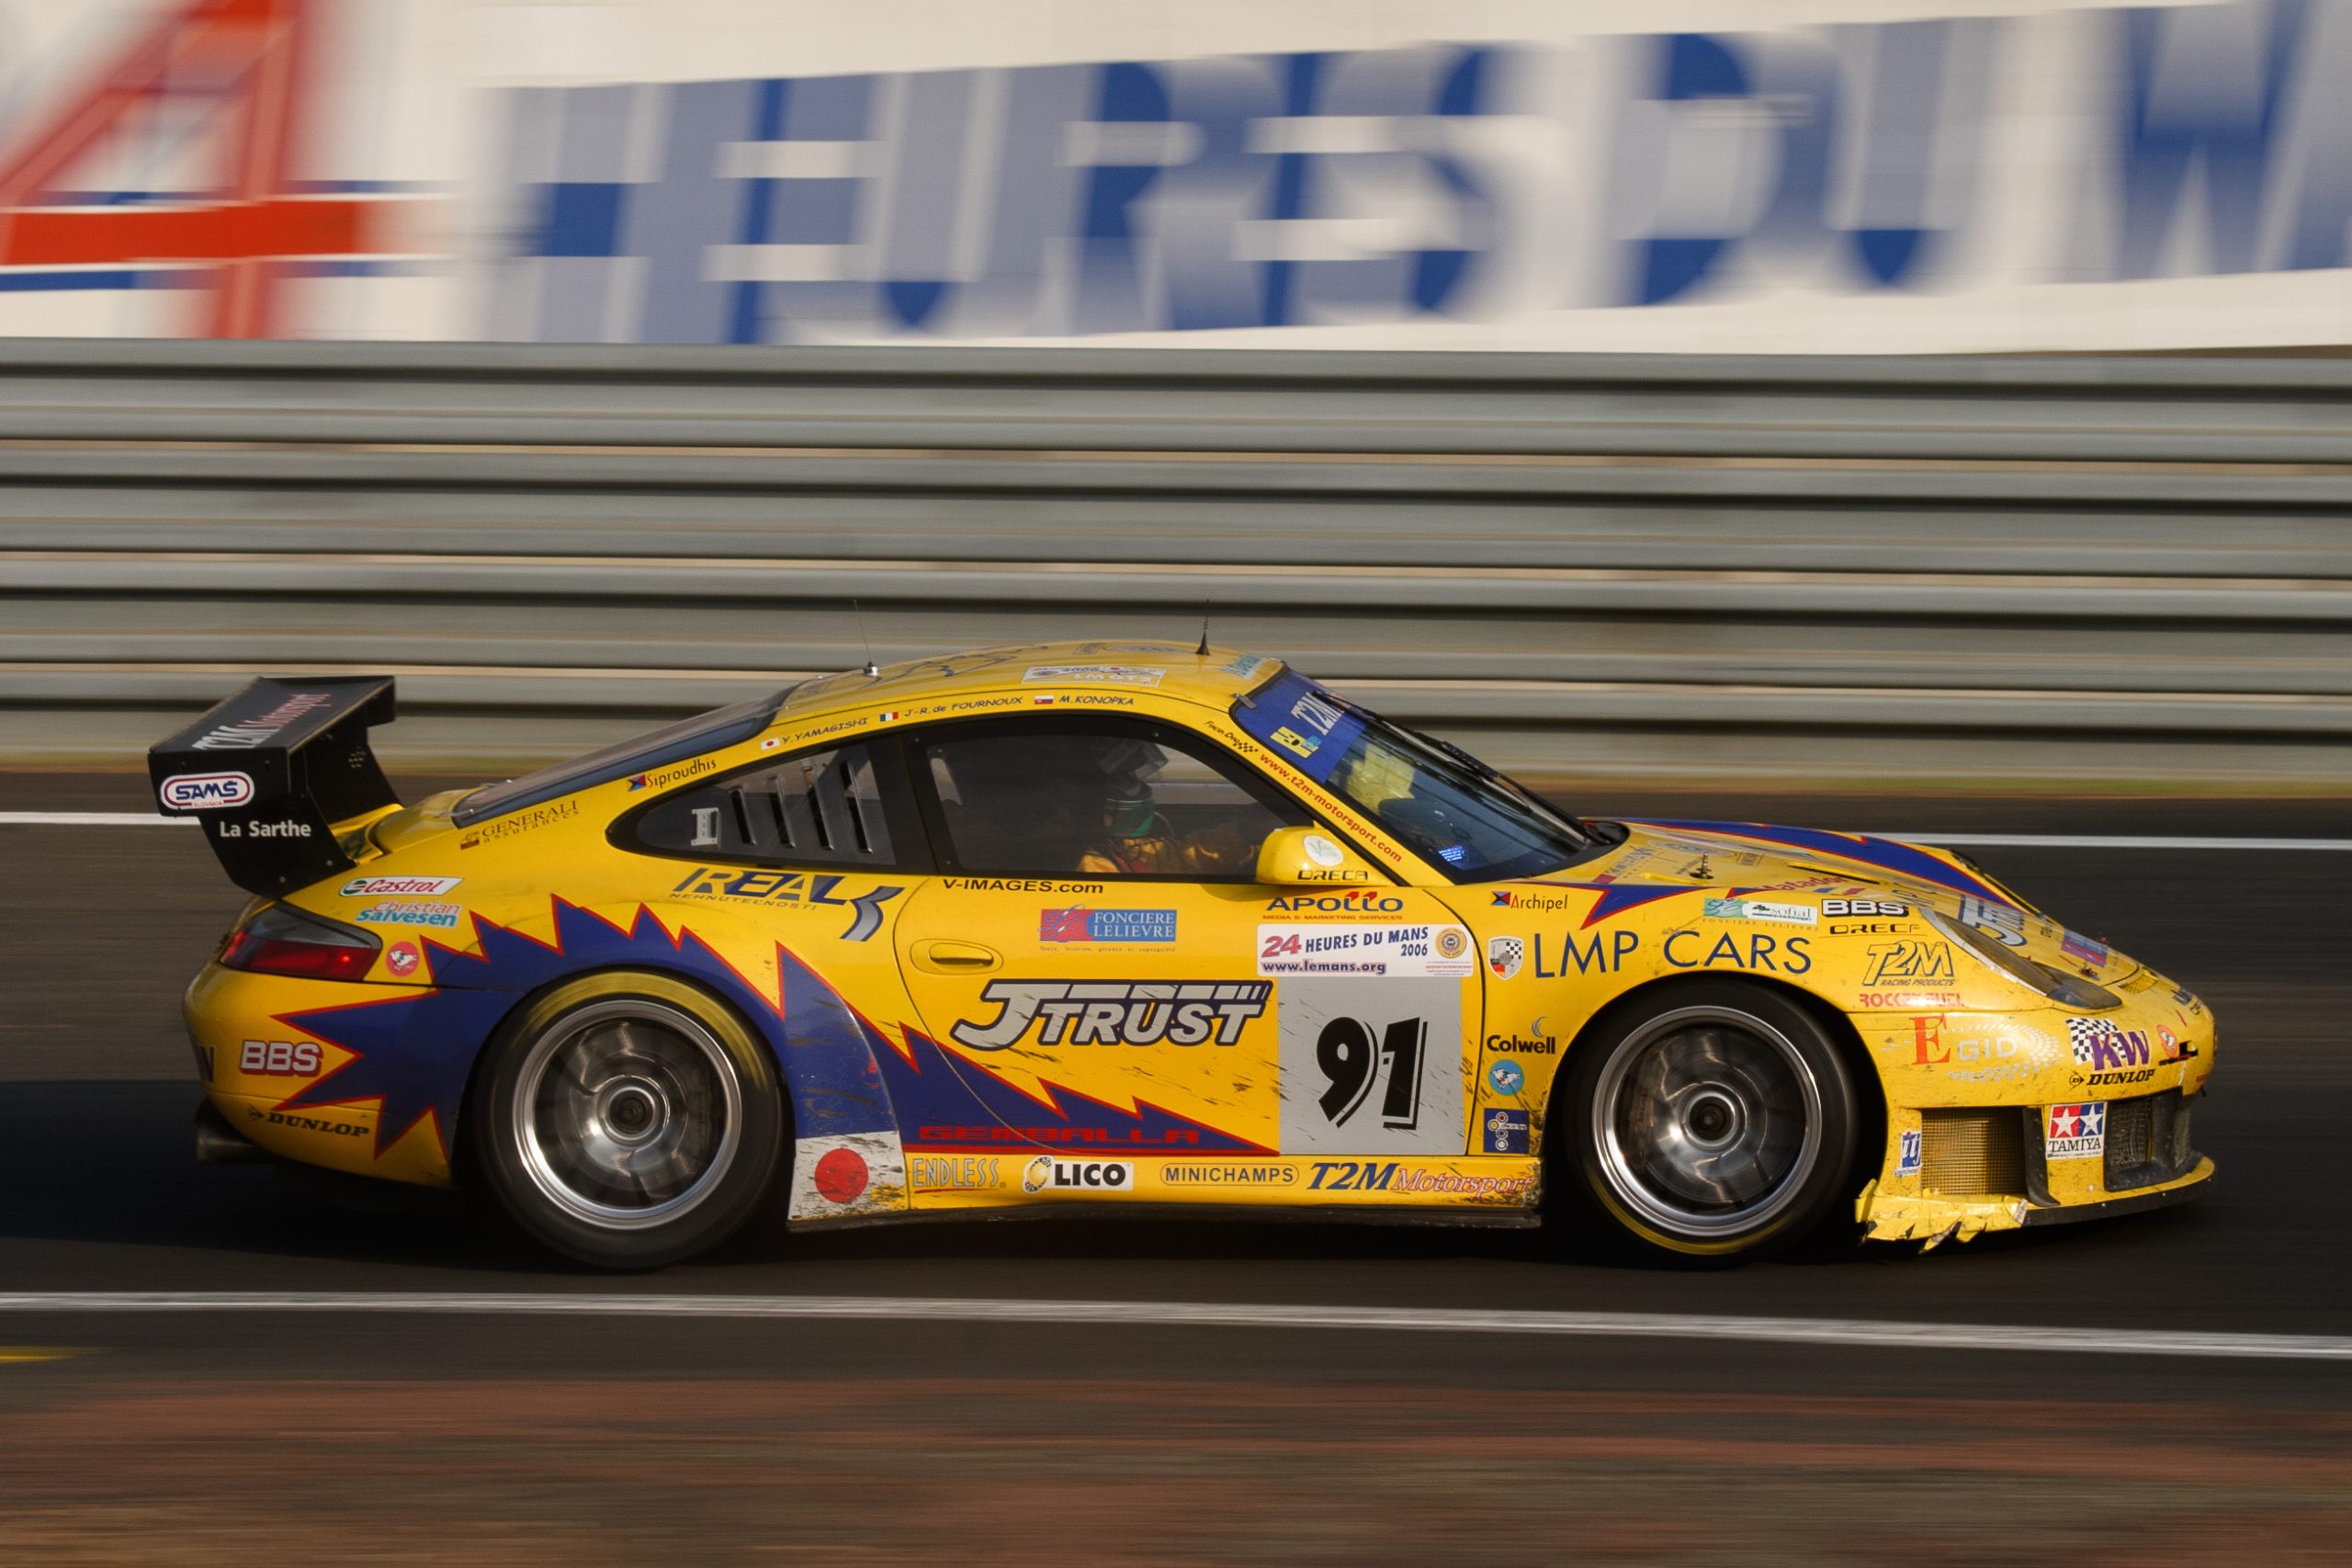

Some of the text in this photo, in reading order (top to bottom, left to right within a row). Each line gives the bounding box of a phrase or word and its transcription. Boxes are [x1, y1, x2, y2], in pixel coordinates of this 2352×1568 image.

[951, 695, 1024, 711] FOURNOUX
[645, 758, 717, 789] Siproudhis
[1260, 753, 1402, 862] www.t2m-motorsport.com
[220, 819, 311, 838] La Sarthe
[481, 800, 580, 837] GENERALI
[366, 878, 446, 894] Castrol
[943, 878, 1103, 894] V-IMAGES.com
[372, 900, 460, 914] Christian
[1266, 891, 1404, 912] APOLLO
[1510, 894, 1568, 913] Archipel
[1822, 898, 1908, 919] BBS
[356, 908, 458, 928] Salvesen
[1093, 912, 1175, 924] FONCIERE
[1093, 924, 1175, 938] LELIEVRE
[1261, 926, 1429, 958] 24 HEURES DU MANS
[1400, 943, 1428, 956] 2006
[1533, 930, 1813, 979] LMP CARS
[1861, 939, 1955, 987] T2M
[1261, 960, 1386, 976] www.lemans.org
[1487, 1034, 1556, 1055] Colwell
[2087, 1029, 2153, 1071] KW
[241, 1040, 322, 1075] BBS
[1317, 1016, 1429, 1130] 91
[2086, 1068, 2156, 1086] DUNLOP
[266, 1111, 370, 1137] DUNLOP
[920, 1125, 1199, 1144] GEMBALLA
[2049, 1135, 2103, 1153] TAMIYA
[912, 1157, 1000, 1189] ENDLESS
[1054, 1162, 1127, 1186] LICO
[1165, 1167, 1295, 1183] MINICHAMPS
[1307, 1162, 1532, 1202] T2M Motorsport
